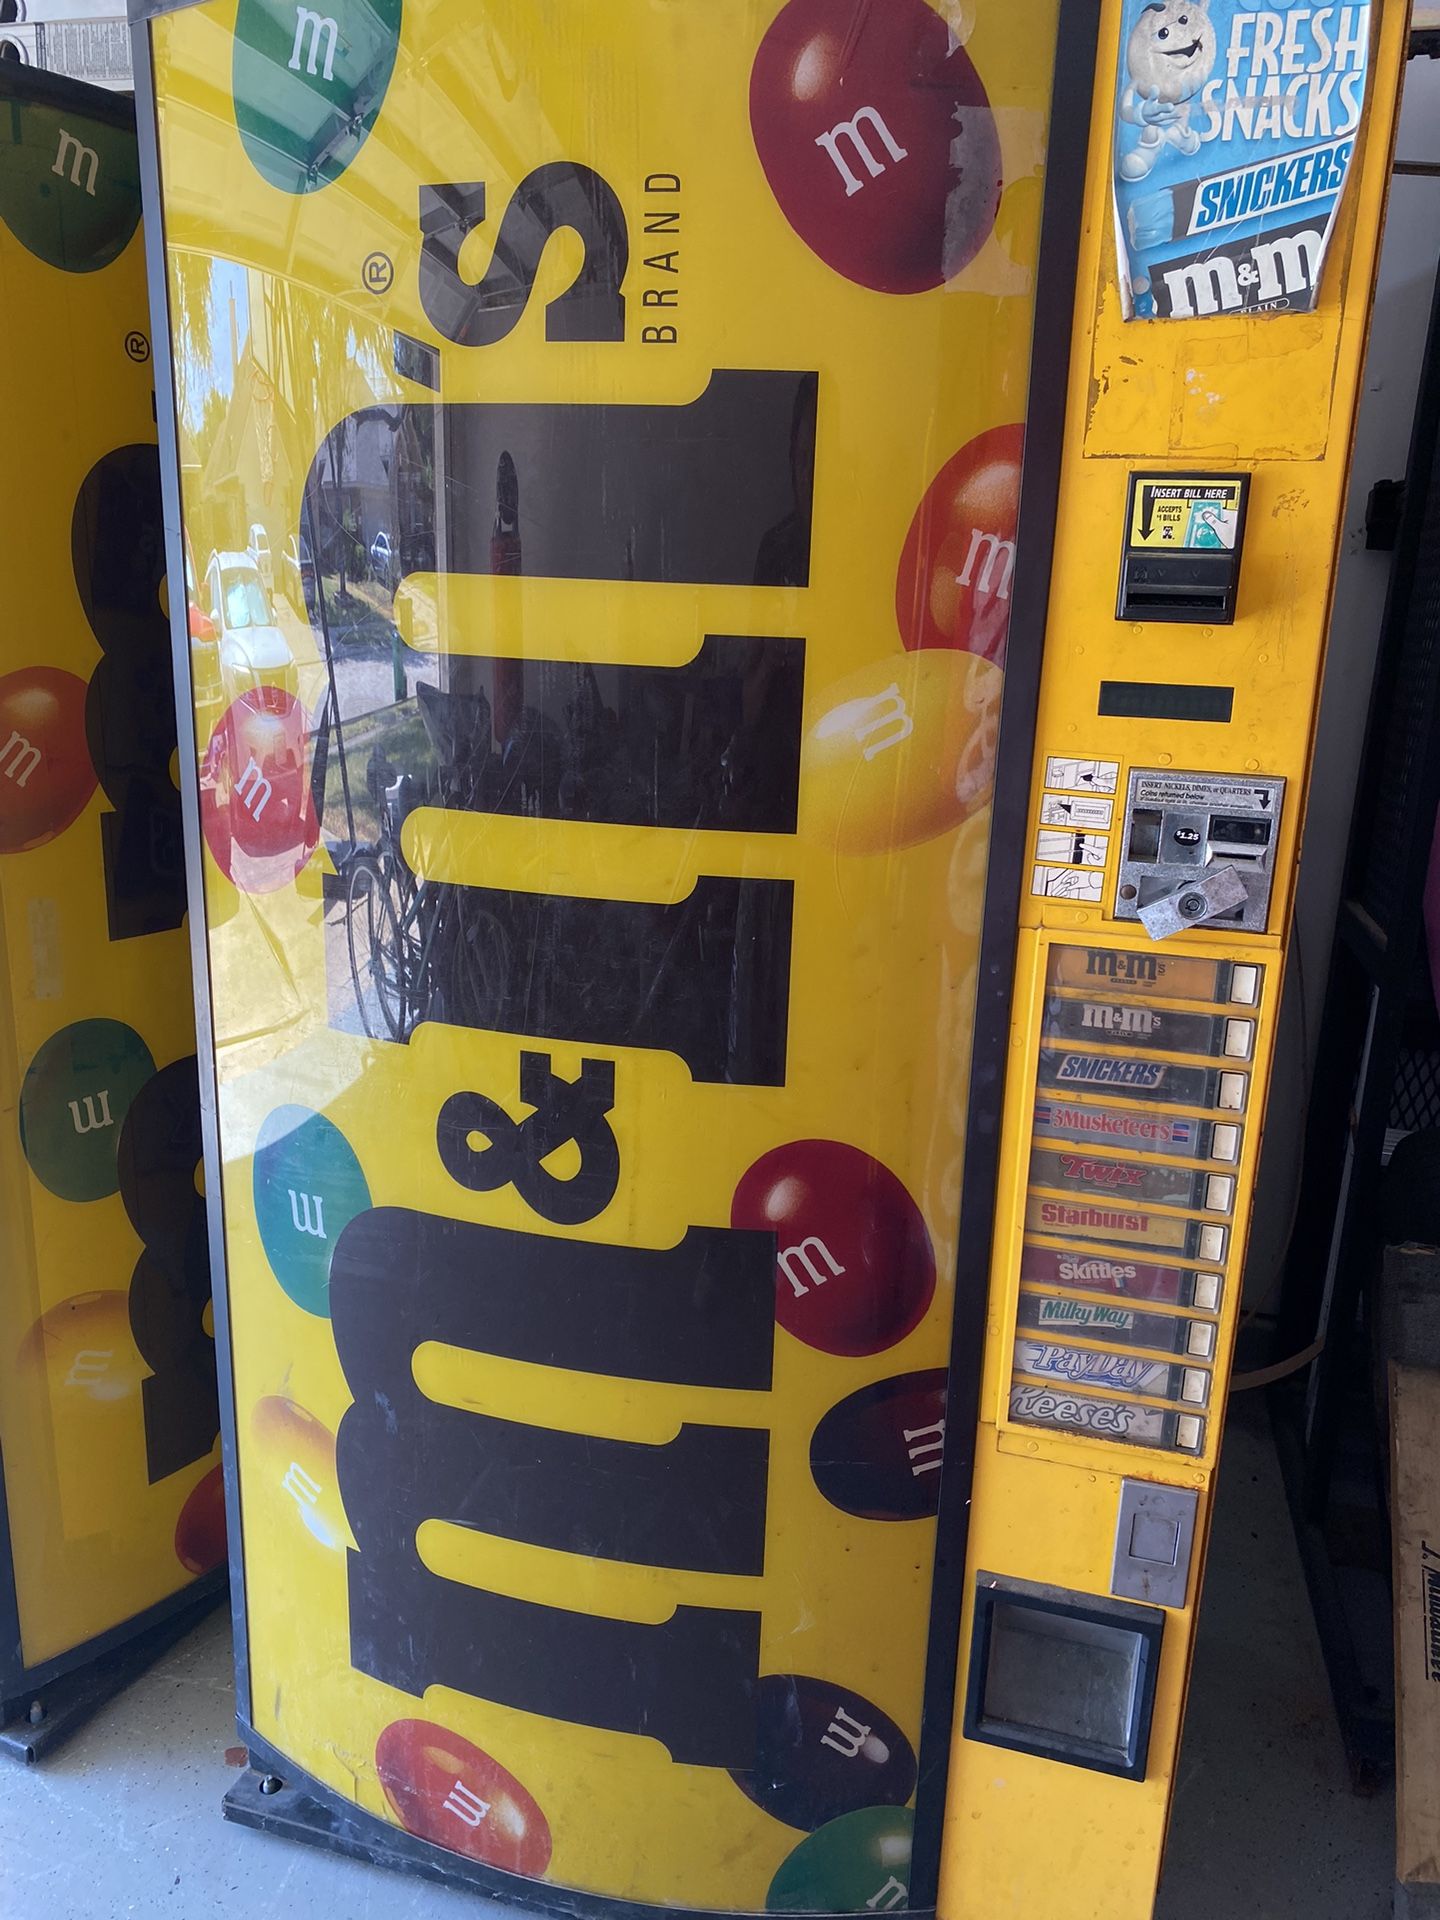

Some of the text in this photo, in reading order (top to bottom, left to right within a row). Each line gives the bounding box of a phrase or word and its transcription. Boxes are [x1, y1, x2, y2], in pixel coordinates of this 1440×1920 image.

[288, 6, 339, 81] m
[1226, 5, 1370, 77] FRESH
[1199, 71, 1362, 142] SNACKS
[51, 129, 100, 196] m
[815, 104, 908, 197] m
[1195, 148, 1350, 228] SNICKERS
[642, 172, 681, 344] BRAND
[1150, 486, 1228, 499] INSERT BILL HERE
[1157, 505, 1182, 513] ACCEPTS
[1163, 514, 1181, 522] BILLS
[955, 528, 1016, 600] m
[845, 682, 914, 761] m
[0, 730, 42, 788] m
[234, 756, 273, 823] m
[1140, 789, 1205, 800] Coins returned below
[1141, 781, 1162, 789] INSERT
[1220, 787, 1252, 796] QUARTERS
[1176, 830, 1200, 841] $1.25
[1081, 1003, 1161, 1034] m&m's
[1061, 1056, 1162, 1086] SNICKERS
[1060, 1154, 1147, 1186] Twix
[1041, 1203, 1150, 1232] Starburst
[778, 1231, 845, 1299] m
[1059, 1262, 1137, 1280] Skittles
[1042, 1301, 1130, 1329] Milky Way
[1034, 1345, 1151, 1387] PayDay
[820, 1706, 871, 1758] m
[444, 1780, 489, 1827] m
